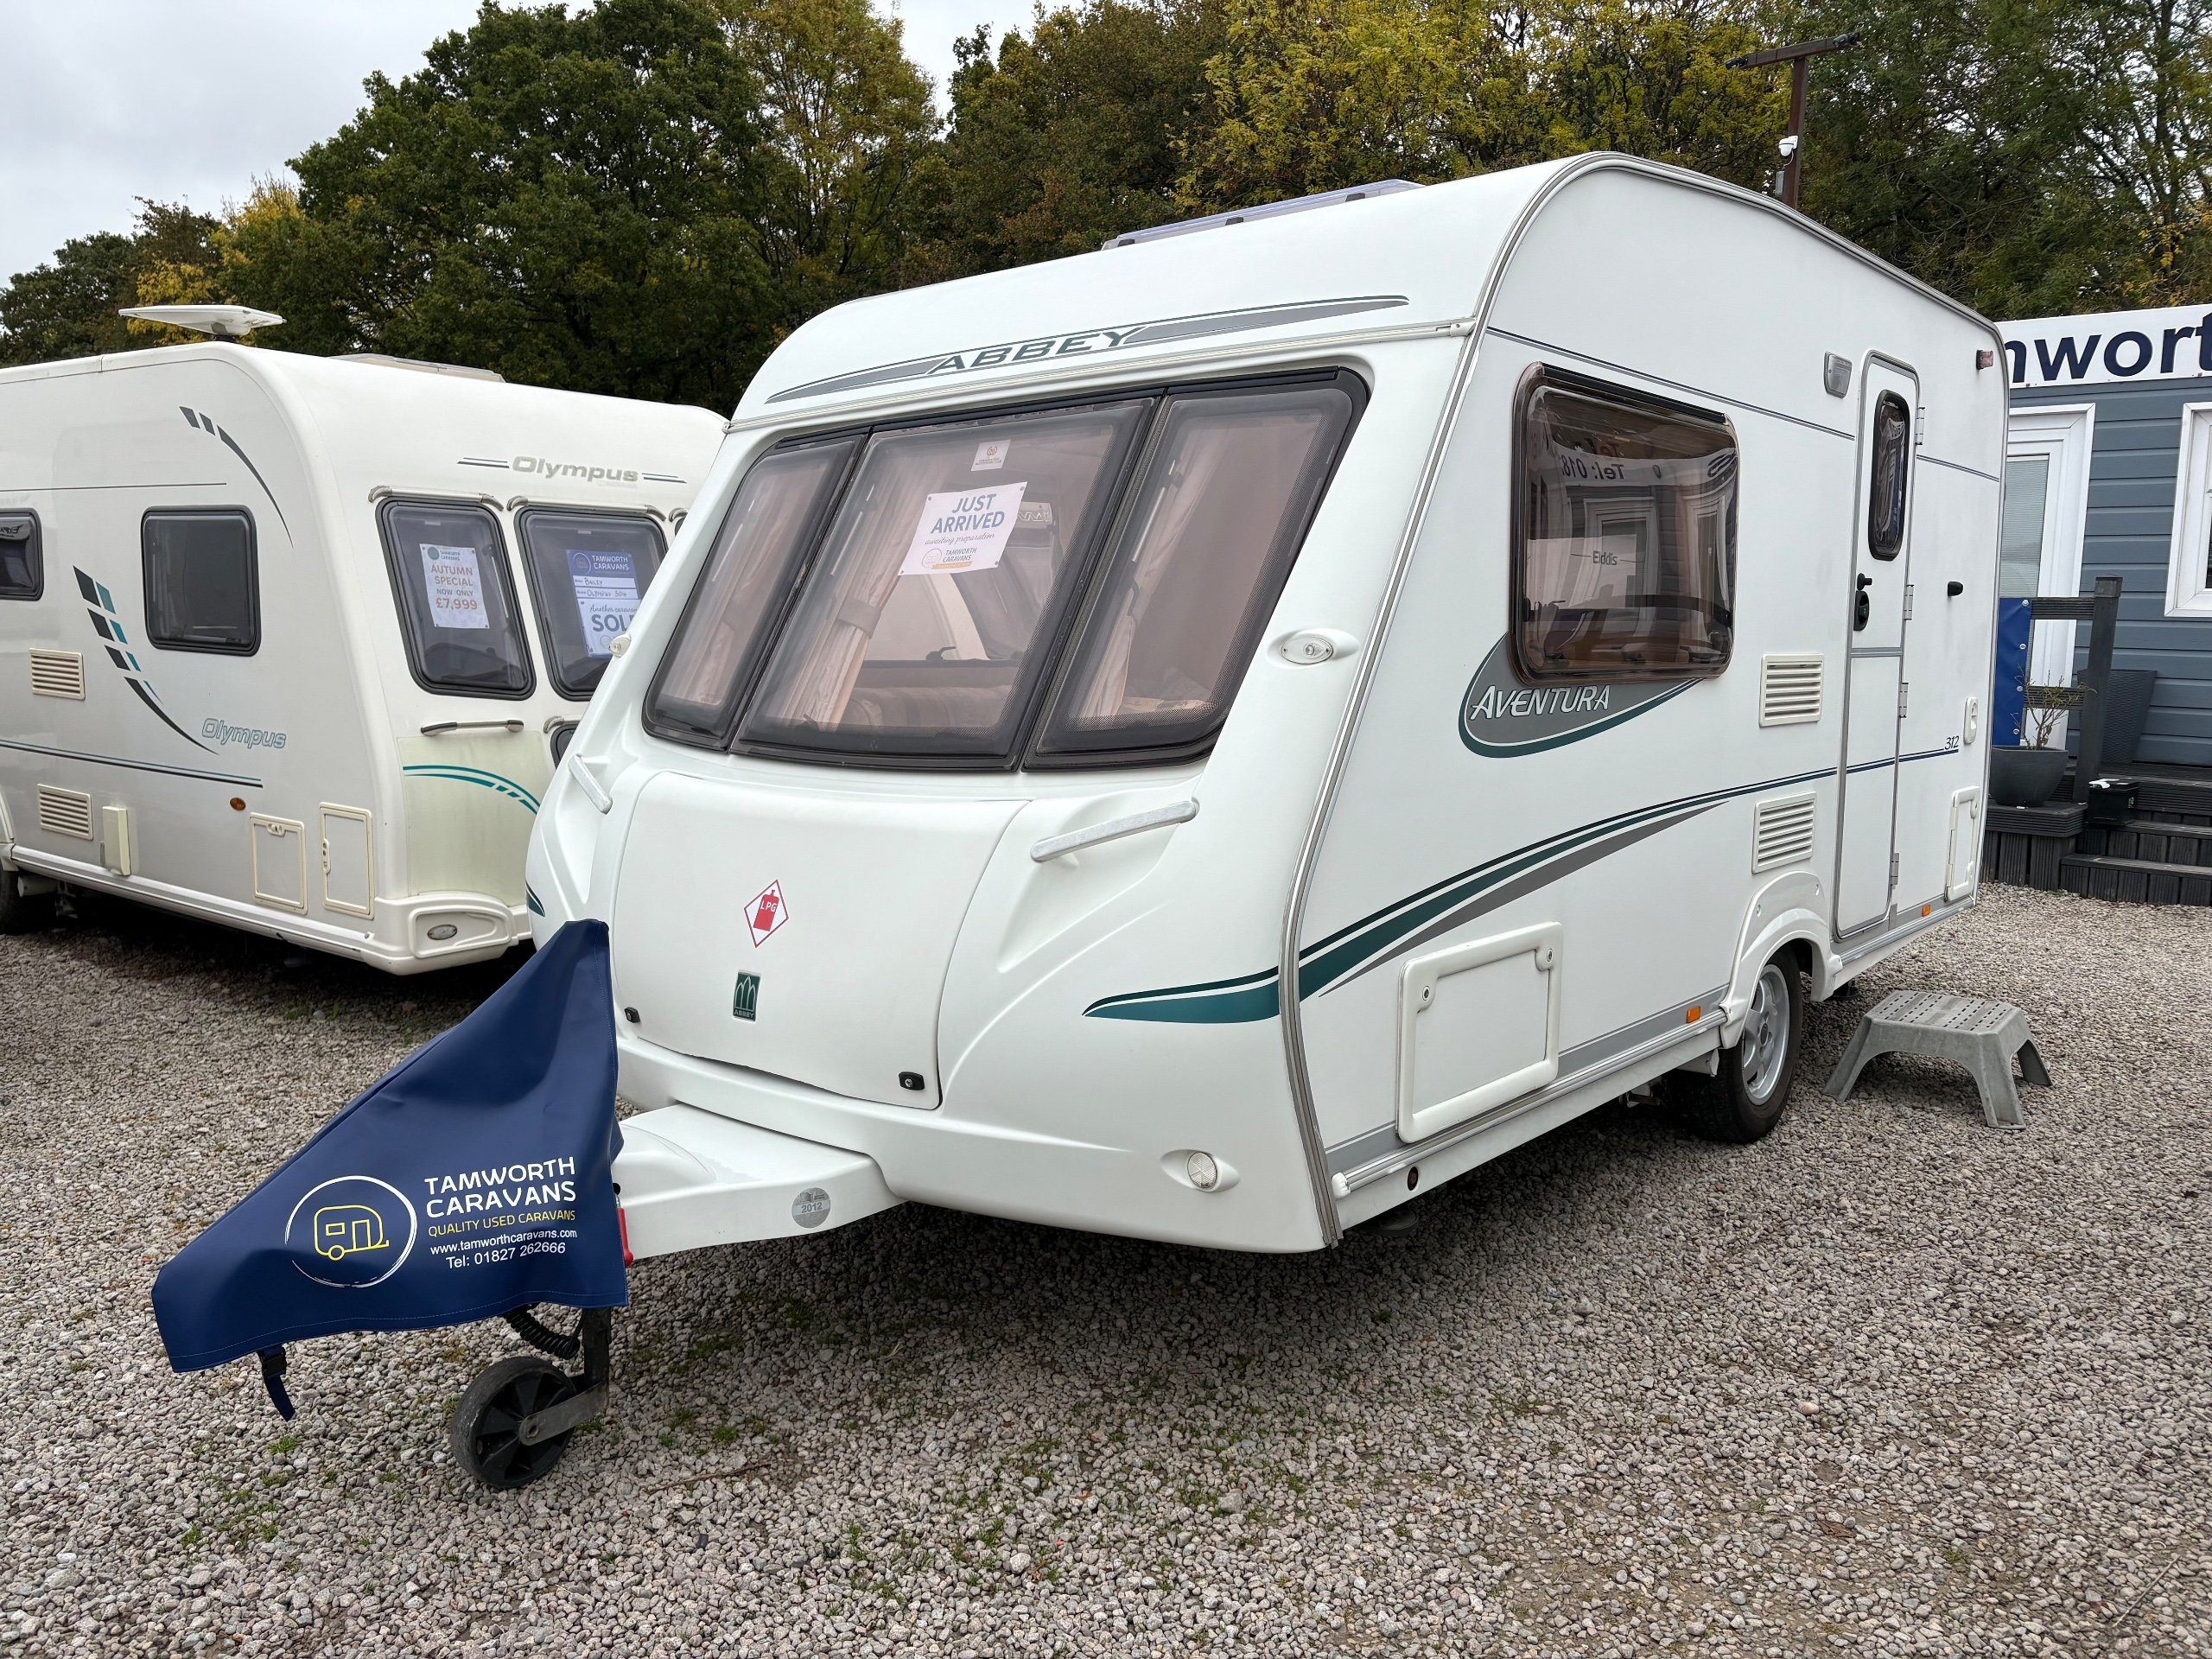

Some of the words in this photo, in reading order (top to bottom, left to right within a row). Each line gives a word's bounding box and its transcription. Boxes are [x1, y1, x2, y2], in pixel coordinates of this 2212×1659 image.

[926, 326, 1147, 374] ABBEY
[512, 455, 639, 482] Olympus
[952, 493, 997, 514] JUST
[931, 511, 1005, 534] ARRIVED
[925, 535, 955, 545] awaiting
[954, 531, 995, 545] preparation
[592, 555, 629, 563] TAMWORTH
[943, 554, 972, 563] CARAVANS
[945, 547, 977, 556] TAMWORTH
[1592, 550, 1618, 566] Elddis
[431, 564, 474, 575] AUTUMN
[593, 562, 630, 571] CARAVANS
[435, 575, 474, 587] SPECIAL
[435, 597, 478, 610] £7,999
[590, 604, 614, 613] Another
[591, 613, 635, 632] SOL
[1470, 684, 1611, 721] AVENTURA
[201, 717, 287, 749] Olympus
[1944, 735, 1960, 750] 312
[760, 899, 778, 912] LPG
[424, 1156, 575, 1195] TAMWORTH
[426, 1180, 576, 1218] CARAVANS
[801, 1201, 823, 1213] 2012
[429, 1219, 480, 1237] QUALITY
[483, 1215, 516, 1229] USED
[518, 1210, 575, 1224] CARAVANS
[430, 1229, 577, 1255] www.tamworthcaravans.com
[446, 1255, 470, 1269] Tel:
[474, 1247, 516, 1265] 01827
[520, 1242, 566, 1257] 262666
